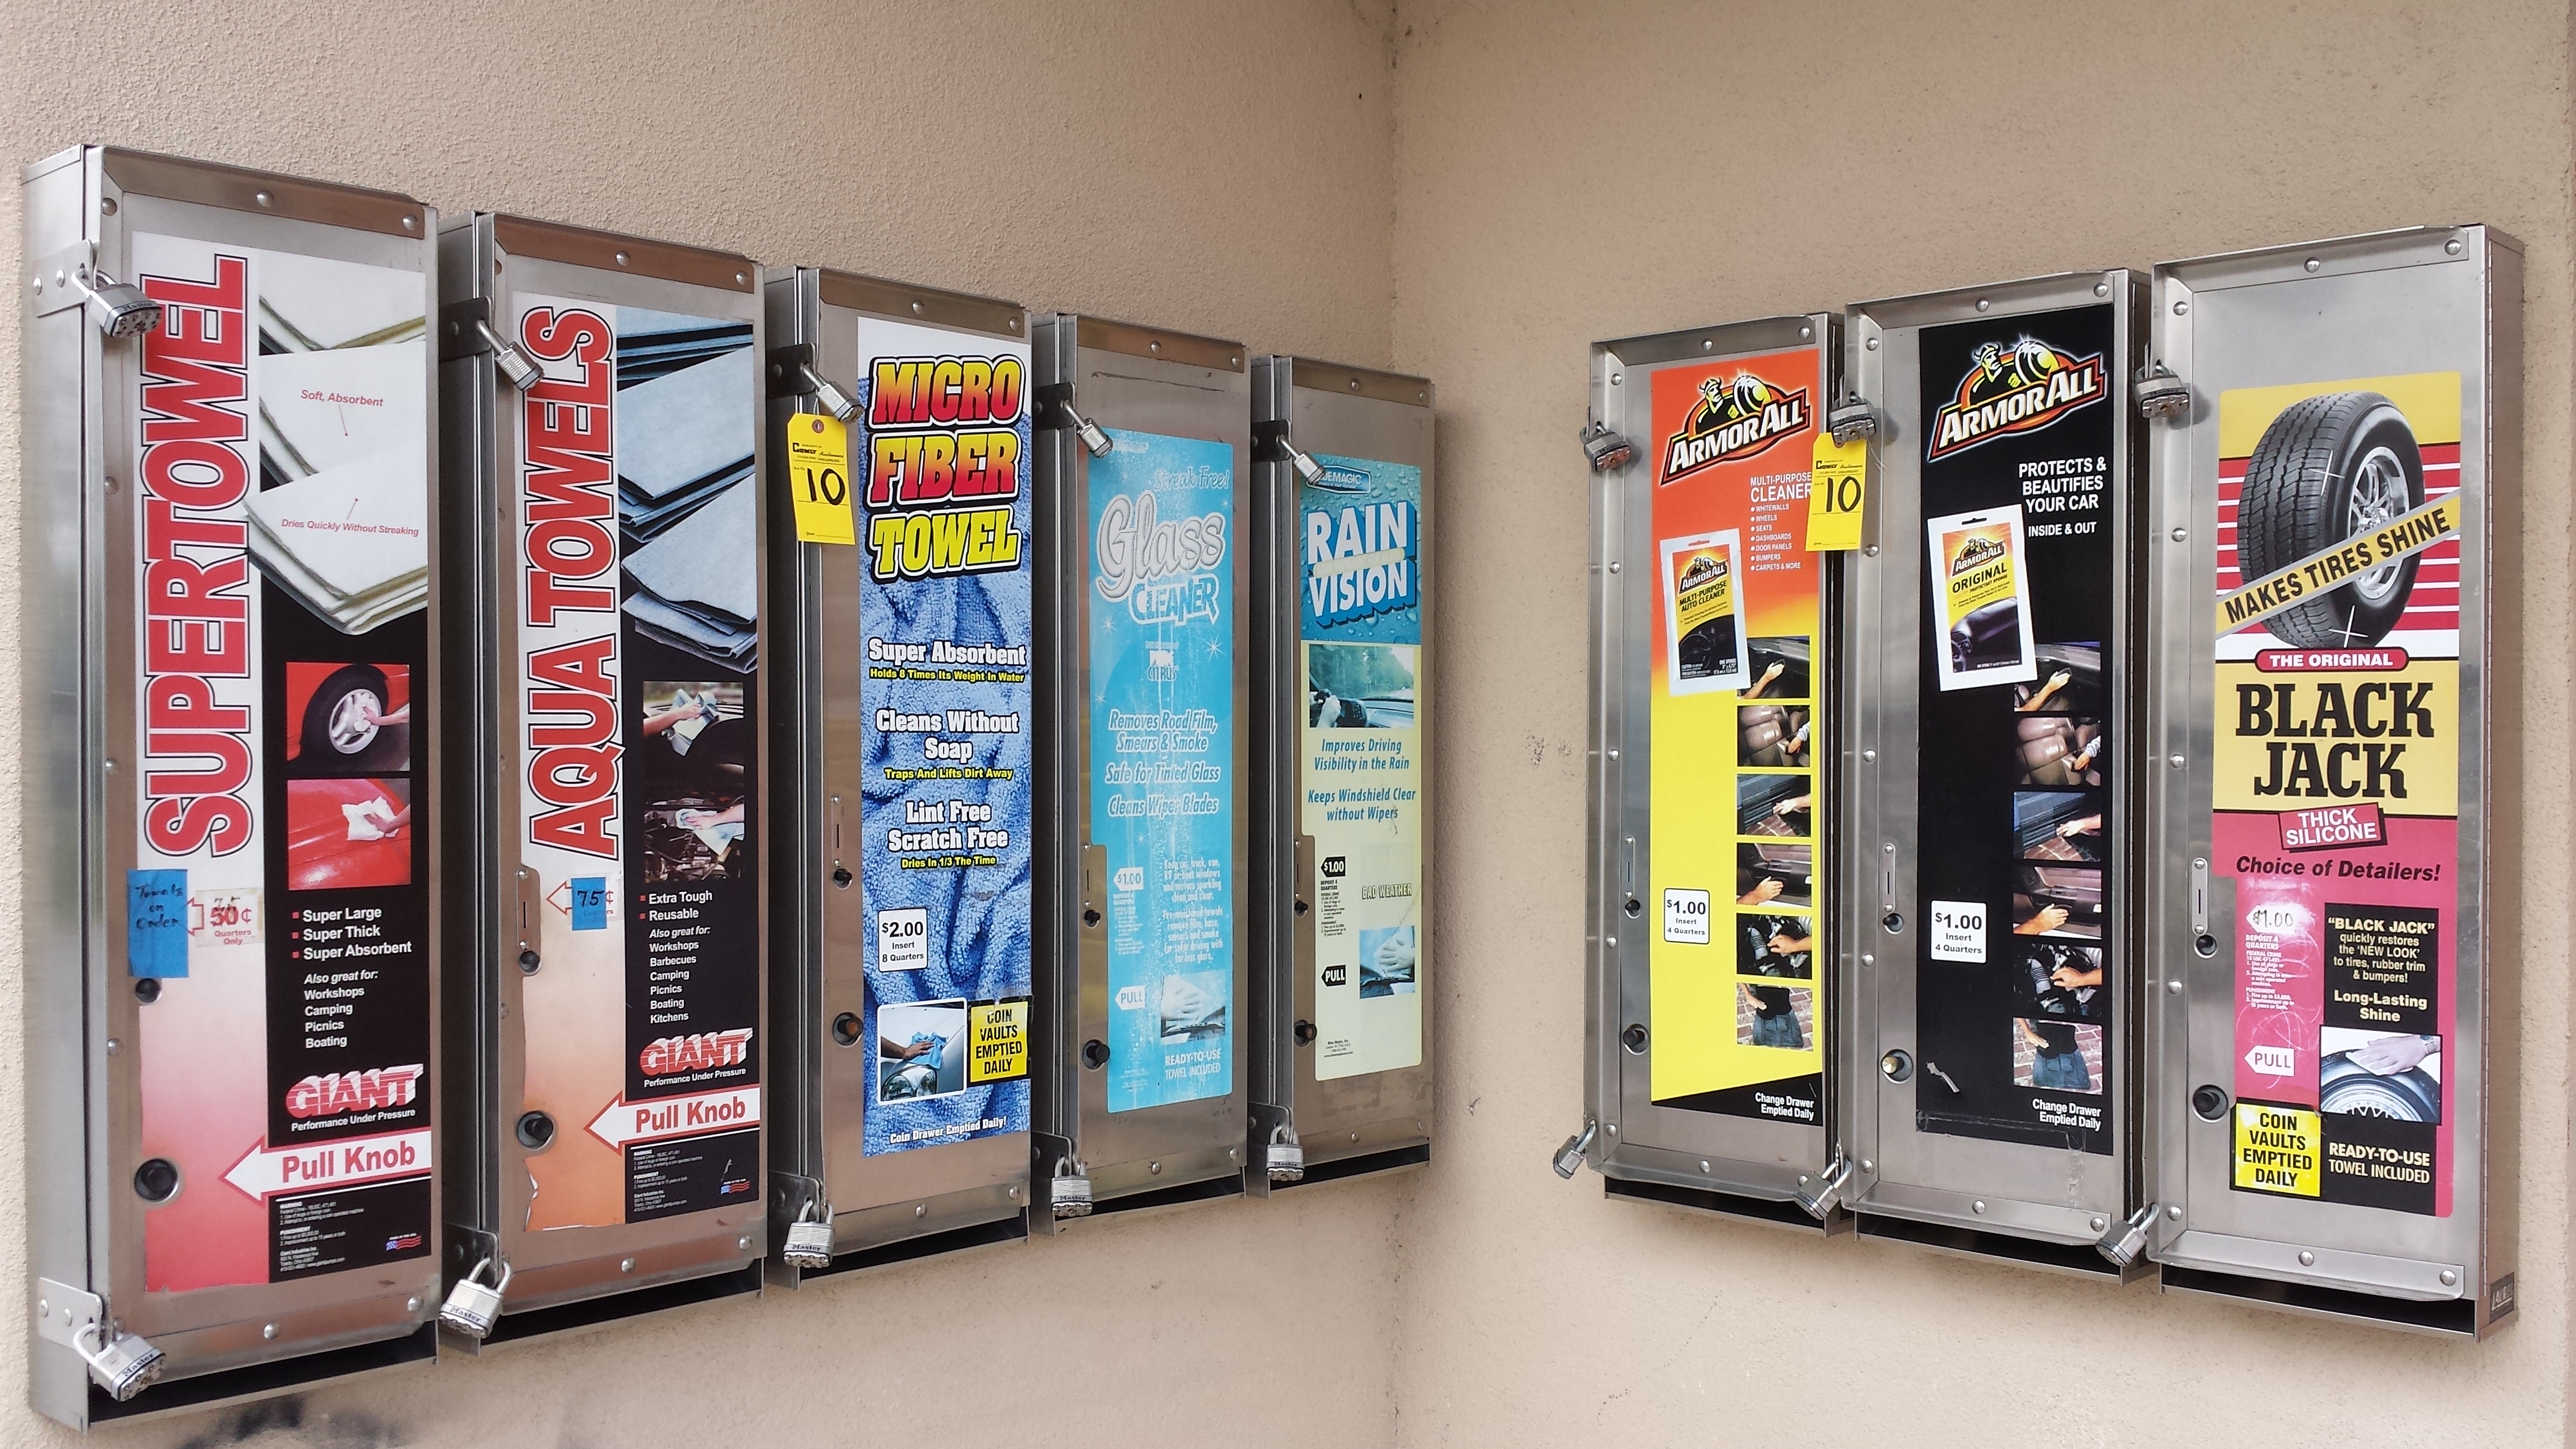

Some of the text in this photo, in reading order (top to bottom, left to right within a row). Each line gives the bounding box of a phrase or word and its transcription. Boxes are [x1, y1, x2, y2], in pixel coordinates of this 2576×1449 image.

[301, 389, 383, 407] Soft, Absorbent
[869, 356, 1023, 427] MICRO
[867, 428, 1020, 506] FIBER
[2019, 456, 2107, 477] PROTECTS &
[807, 468, 845, 505] 10
[1750, 472, 1812, 485] MULTI-PURPOSE
[2022, 476, 2103, 495] BEAUTIFIES
[1750, 483, 1812, 502] CLEANER
[1826, 476, 1861, 512] 10
[1756, 504, 1790, 512] WHITEWALLS
[2026, 494, 2099, 513] YOUR CAR
[281, 519, 419, 537] Dries Quickly Without Streaking
[1307, 501, 1408, 565] RAIN
[2028, 522, 2096, 537] INSIDE & OUT
[870, 505, 1022, 578] TOWEL
[1097, 490, 1225, 602] Glass
[1756, 534, 1792, 542] DASHBOARDS
[140, 253, 251, 858] SUPERTOWEL
[2225, 507, 2451, 623] MAKES TIRES SHINE
[520, 306, 625, 860] AQUA TOWELS
[1953, 562, 2007, 593] ORIGINAL
[1308, 560, 1408, 617] VISION
[1679, 580, 1727, 606] MULTI-PURPOSE
[1129, 573, 1219, 625] CLEANER
[1681, 588, 1725, 613] AUTO CLEANER
[869, 638, 1026, 665] Super Absorbent
[2270, 653, 2393, 666] THE ORIGINAL
[870, 668, 1024, 682] Holds 8 Times Its Weight In Water
[1109, 709, 1158, 730] Removes
[1161, 710, 1189, 730] Road
[2235, 682, 2434, 738] BLACK
[876, 710, 1018, 733] Cleans Without
[925, 737, 972, 764] Soap
[1117, 731, 1209, 753] Smears & Smoke
[1322, 738, 1402, 754] Improves Driving
[1314, 756, 1410, 773] Visibility in the Rain
[2254, 742, 2407, 799] JACK
[1308, 788, 1416, 806] Keeps Windshield Clear
[1327, 806, 1398, 822] without Wipers
[2298, 808, 2358, 828] THICK
[2286, 822, 2377, 845] SILICONE
[1324, 861, 1344, 872] $1.00
[2237, 856, 2441, 881] Choice of Detailers!
[577, 890, 605, 907] 75
[648, 890, 713, 905] Extra Tough
[1362, 884, 1412, 899] BAD WEATHER
[303, 907, 381, 924] Super Large
[648, 909, 699, 921] Reusable
[1667, 899, 1705, 915] $1.00
[303, 925, 381, 943] Super Thick
[882, 921, 924, 938] $2.00
[892, 941, 915, 949] Insert
[2246, 942, 2279, 950] QUARTERS
[2340, 933, 2419, 946] quickly restores
[304, 941, 412, 962] Super Absorbent
[650, 955, 696, 967] Barbecues
[882, 952, 924, 962] 8 Quarters
[305, 970, 378, 985] Also great for:
[650, 970, 689, 981] Camping
[1325, 968, 1345, 982] PULL
[305, 987, 364, 1000] Workshops
[650, 985, 682, 995] Picnics
[650, 998, 684, 1010] Boating
[2334, 990, 2427, 1010] Long-Lasting
[650, 1012, 688, 1023] Kitchens
[987, 1009, 1012, 1025] COIN
[2359, 1008, 2401, 1022] Shine
[980, 1025, 1017, 1042] VAULTS
[640, 1028, 753, 1076] GIANT
[976, 1041, 1022, 1059] EMPTIED
[1166, 1049, 1221, 1066] READY-TO-USE
[984, 1058, 1013, 1075] DAILY
[2255, 1053, 2291, 1068] PULL
[644, 1068, 746, 1088] Performance Under Pressure
[1165, 1063, 1221, 1080] TOWEL INCLUDED
[285, 1063, 423, 1118] GIANT
[636, 1096, 745, 1133] Pull Knob
[2032, 1098, 2101, 1117] Change Drawer
[2040, 1111, 2101, 1132] Emptied Daily
[2260, 1113, 2297, 1130] COIN
[2250, 1130, 2306, 1150] VAULTS
[282, 1140, 415, 1183] Pull Knob
[2243, 1148, 2312, 1170] EMPTIED
[2330, 1142, 2430, 1166] READY-TO-USE
[2256, 1168, 2298, 1187] DAILY
[2329, 1159, 2429, 1184] TOWEL INCLUDED
